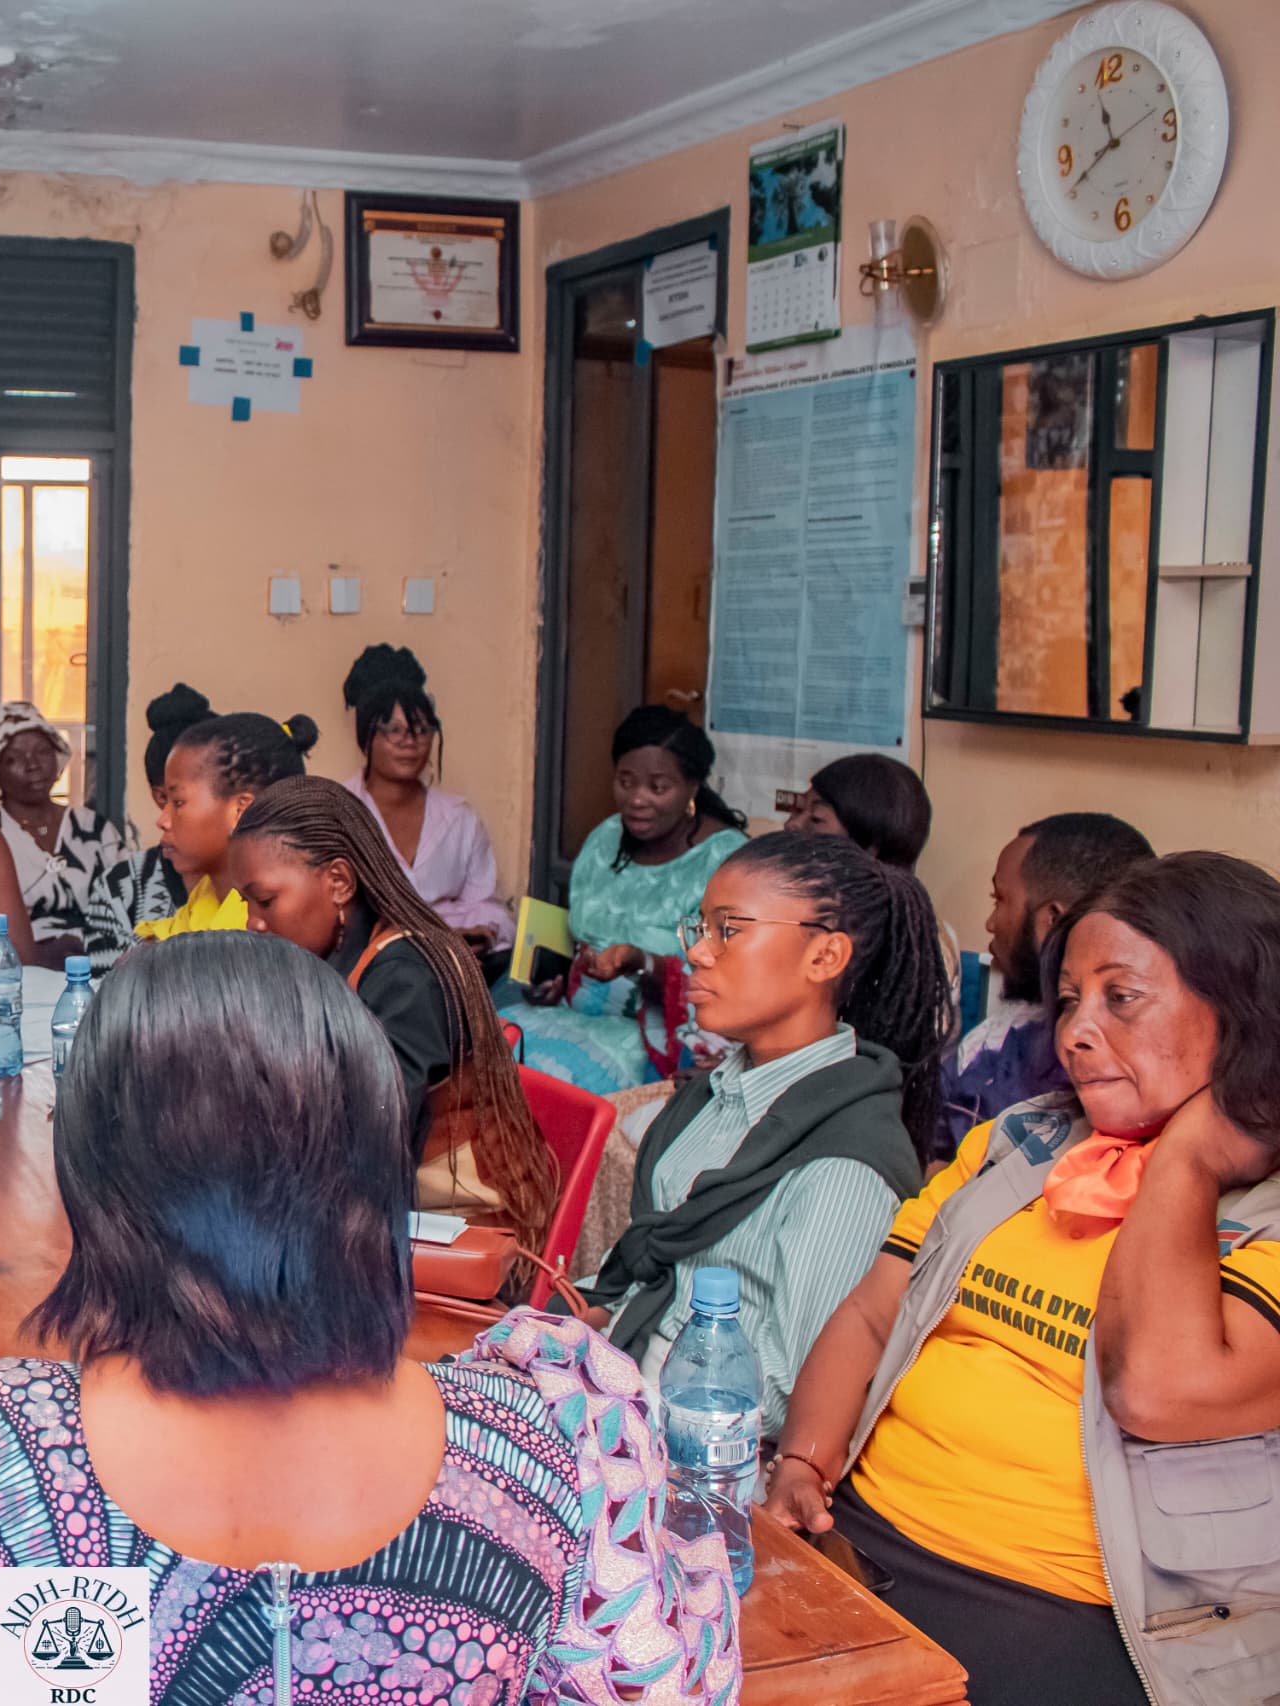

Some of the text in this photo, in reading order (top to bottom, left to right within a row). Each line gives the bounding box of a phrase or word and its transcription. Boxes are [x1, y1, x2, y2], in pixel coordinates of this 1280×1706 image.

[1094, 54, 1123, 89] 12
[1161, 108, 1177, 143] 3
[1057, 144, 1073, 177] 9
[1114, 197, 1132, 232] 6
[971, 1263, 1019, 1298] POUR
[1022, 1284, 1044, 1309] LA
